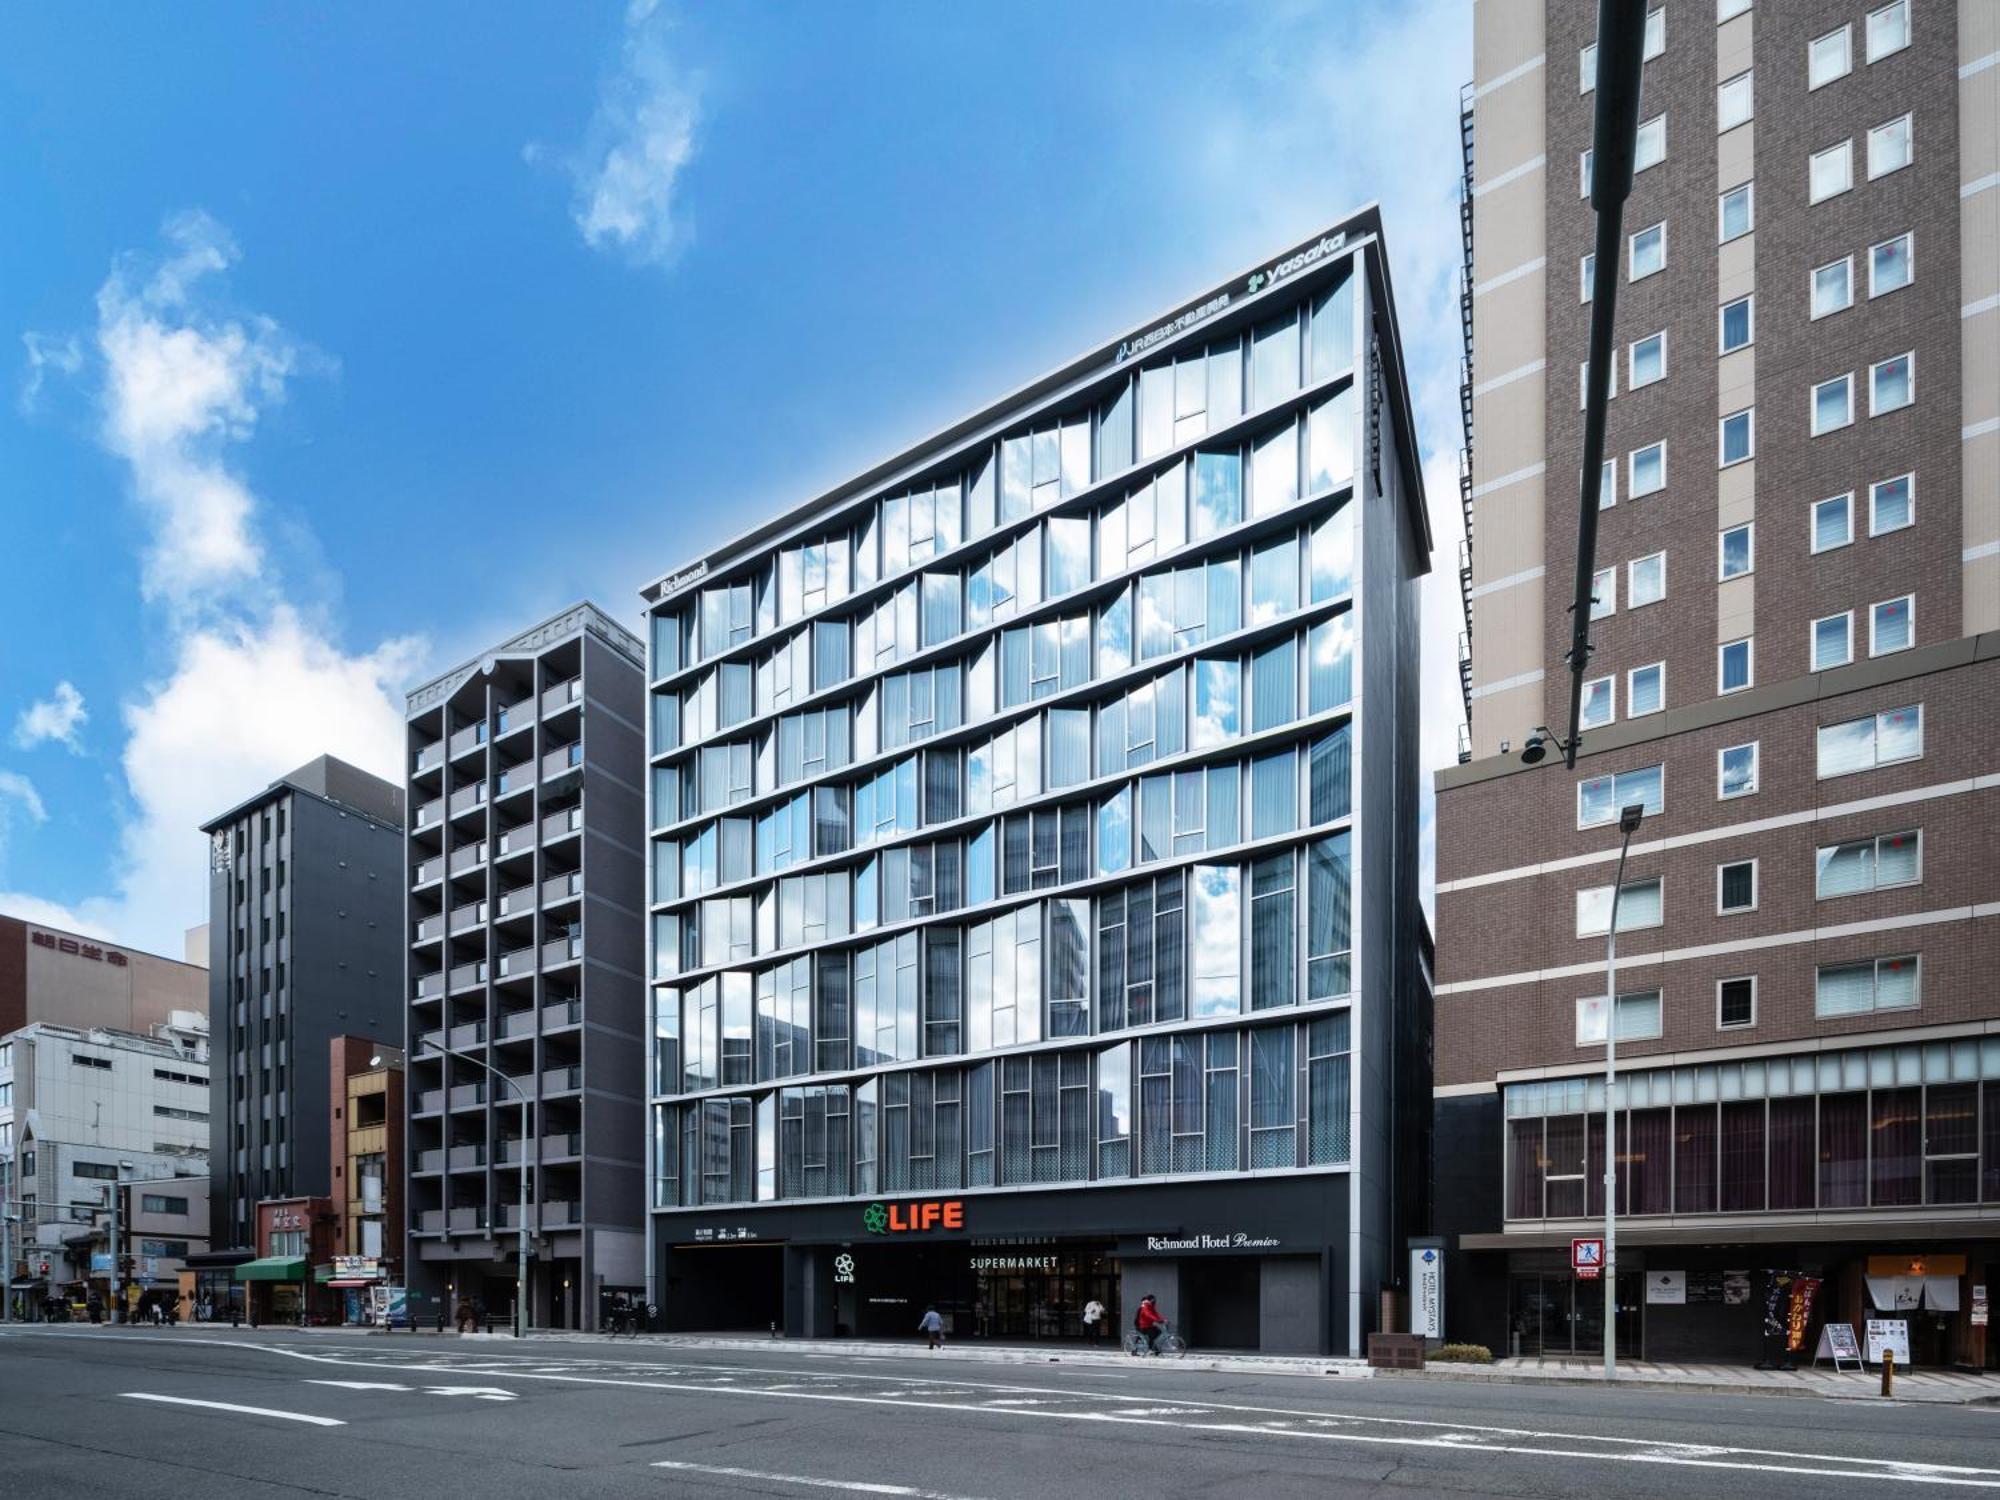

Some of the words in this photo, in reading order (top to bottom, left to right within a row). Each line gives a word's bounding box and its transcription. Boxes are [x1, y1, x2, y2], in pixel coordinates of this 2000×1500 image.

[1266, 231, 1346, 286] yasaka
[660, 559, 709, 598] Richmond
[889, 1202, 963, 1231] LIFE
[1147, 1236, 1200, 1251] Richmond
[1201, 1234, 1230, 1249] Hotel
[1231, 1232, 1281, 1248] Premier
[970, 1256, 1058, 1269] SUPERMARKET
[1427, 1272, 1437, 1295] HOTEL
